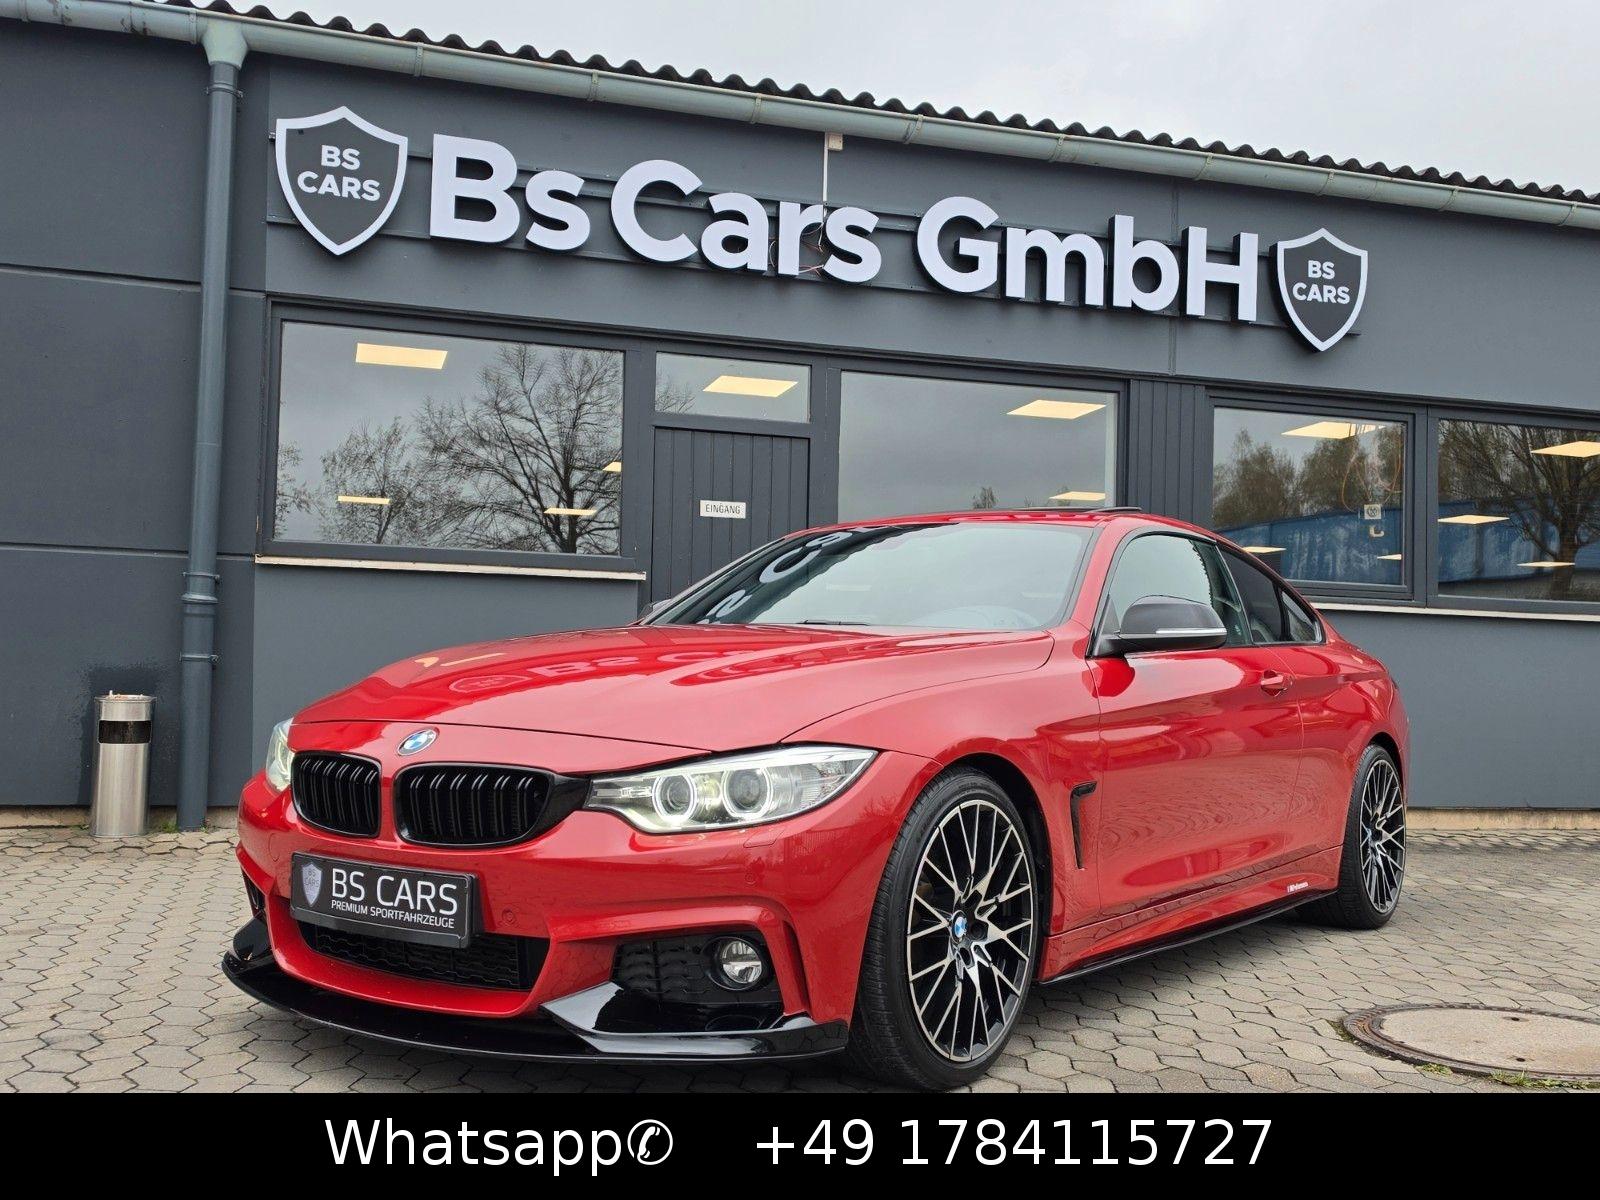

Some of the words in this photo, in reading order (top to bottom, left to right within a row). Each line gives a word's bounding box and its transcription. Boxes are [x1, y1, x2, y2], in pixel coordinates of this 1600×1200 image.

[321, 145, 360, 170] BS
[297, 171, 380, 201] CARS
[916, 196, 1258, 322] GmbH
[1308, 260, 1335, 280] BS
[1292, 282, 1351, 304] CARS
[705, 503, 741, 515] EINGANG
[332, 868, 366, 902] BS
[376, 875, 458, 915] CARS
[331, 899, 368, 915] PREMIUM
[370, 906, 454, 928] SPORTFAHRZEUGE
